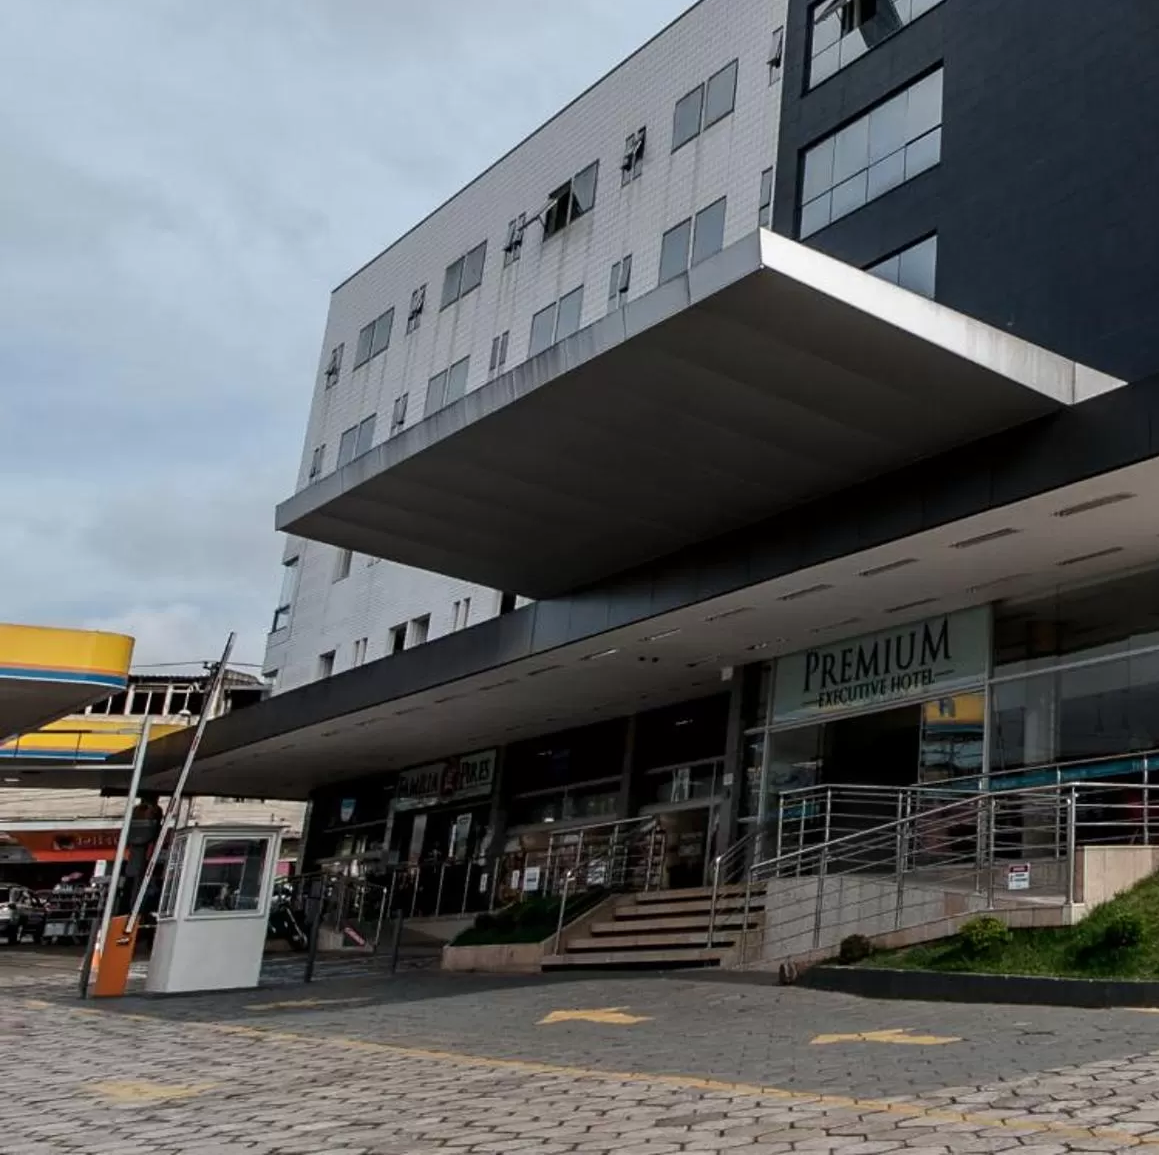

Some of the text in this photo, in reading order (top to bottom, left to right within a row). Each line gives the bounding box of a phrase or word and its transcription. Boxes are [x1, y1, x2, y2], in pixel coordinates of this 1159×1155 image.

[803, 612, 953, 693] PREMIUM
[818, 668, 935, 708] EXECUTIVE HOTEL
